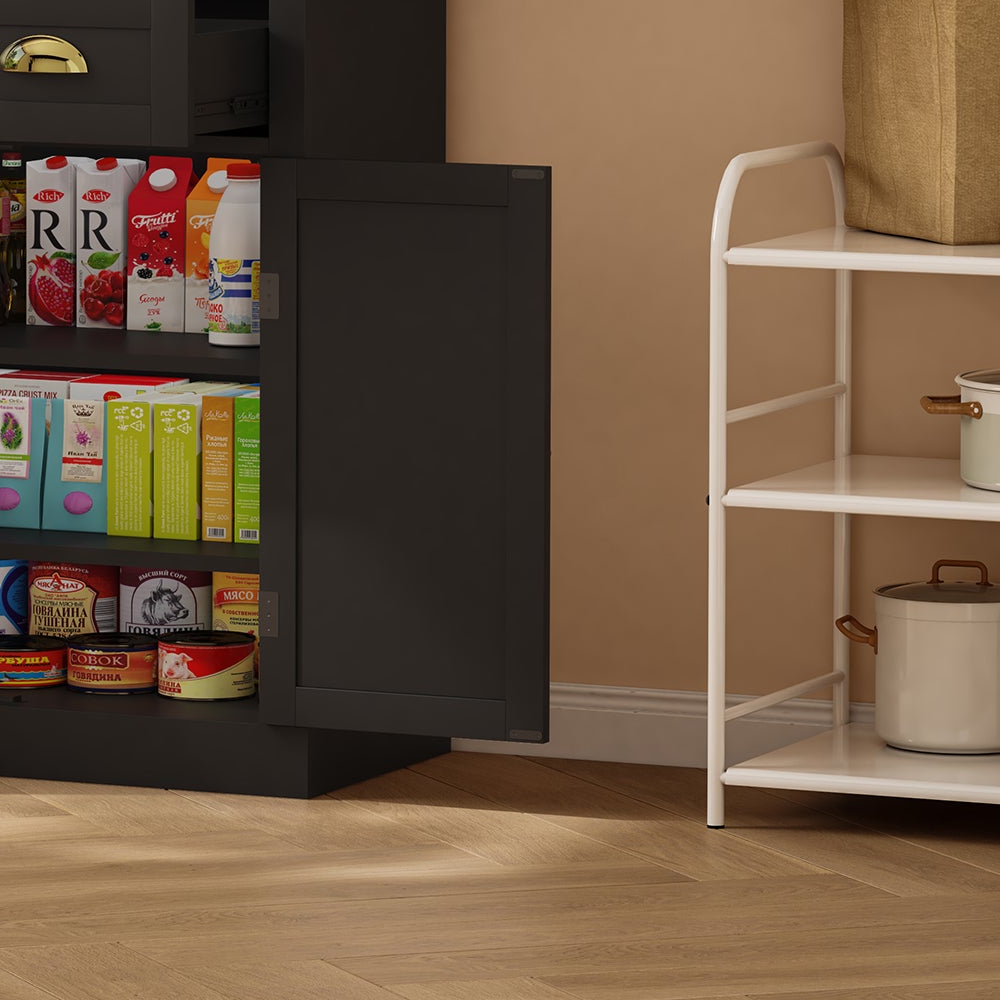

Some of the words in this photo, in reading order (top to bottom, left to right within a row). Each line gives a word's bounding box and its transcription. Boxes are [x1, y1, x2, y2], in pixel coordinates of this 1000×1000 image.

[38, 190, 60, 201] Rich
[85, 190, 107, 201] Rich
[131, 212, 177, 229] Frutti
[30, 209, 65, 250] R
[80, 210, 114, 251] R
[18, 390, 42, 398] CRUST
[138, 570, 169, 582] ВЫСШИЙ
[170, 571, 187, 581] СОРТ
[224, 591, 254, 601] МЯСО
[33, 605, 88, 618] ГОВЯДИНА
[34, 615, 86, 628] ТУШЕНАЯ
[71, 652, 125, 666] СОВОК
[72, 671, 122, 682] ГОВЯДИНА
